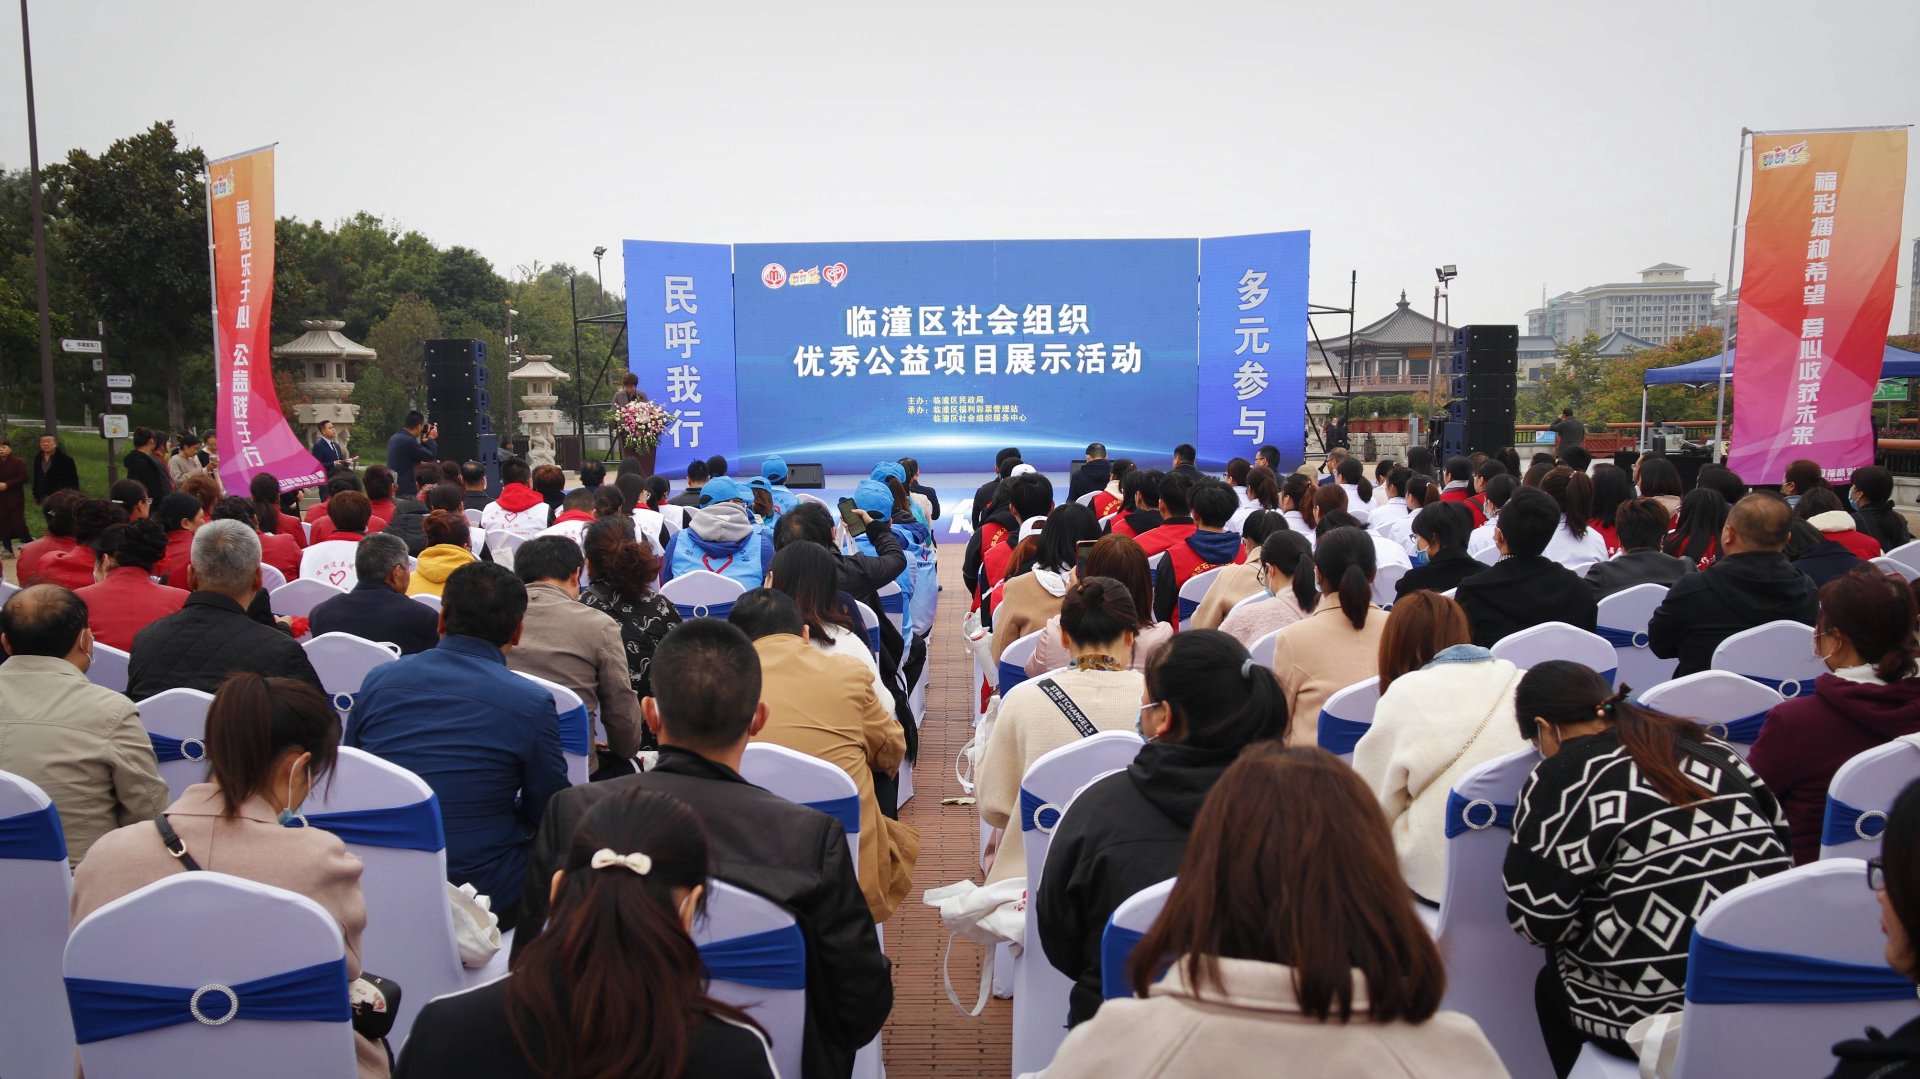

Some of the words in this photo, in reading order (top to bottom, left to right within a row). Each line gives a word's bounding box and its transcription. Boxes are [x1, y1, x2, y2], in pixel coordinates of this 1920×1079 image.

[235, 200, 253, 329] 福彩乐于心
[1803, 172, 1838, 305] 福彩播种希望
[663, 274, 704, 449] 民呼我行
[792, 341, 1143, 378] 优秀公益项目展示活动
[845, 304, 1090, 339] 临潼区社会组织
[1232, 268, 1270, 445] 多元参与
[232, 343, 265, 468] 公益践于行
[933, 395, 985, 405] 临潼区民政局
[933, 405, 1019, 414] 临潼区福利彩票管理站
[933, 414, 1027, 423] 临潼区社会组织服务中心
[1791, 317, 1825, 446] 爱心收获未来
[1050, 685, 1094, 733] STRETCHANGELS
